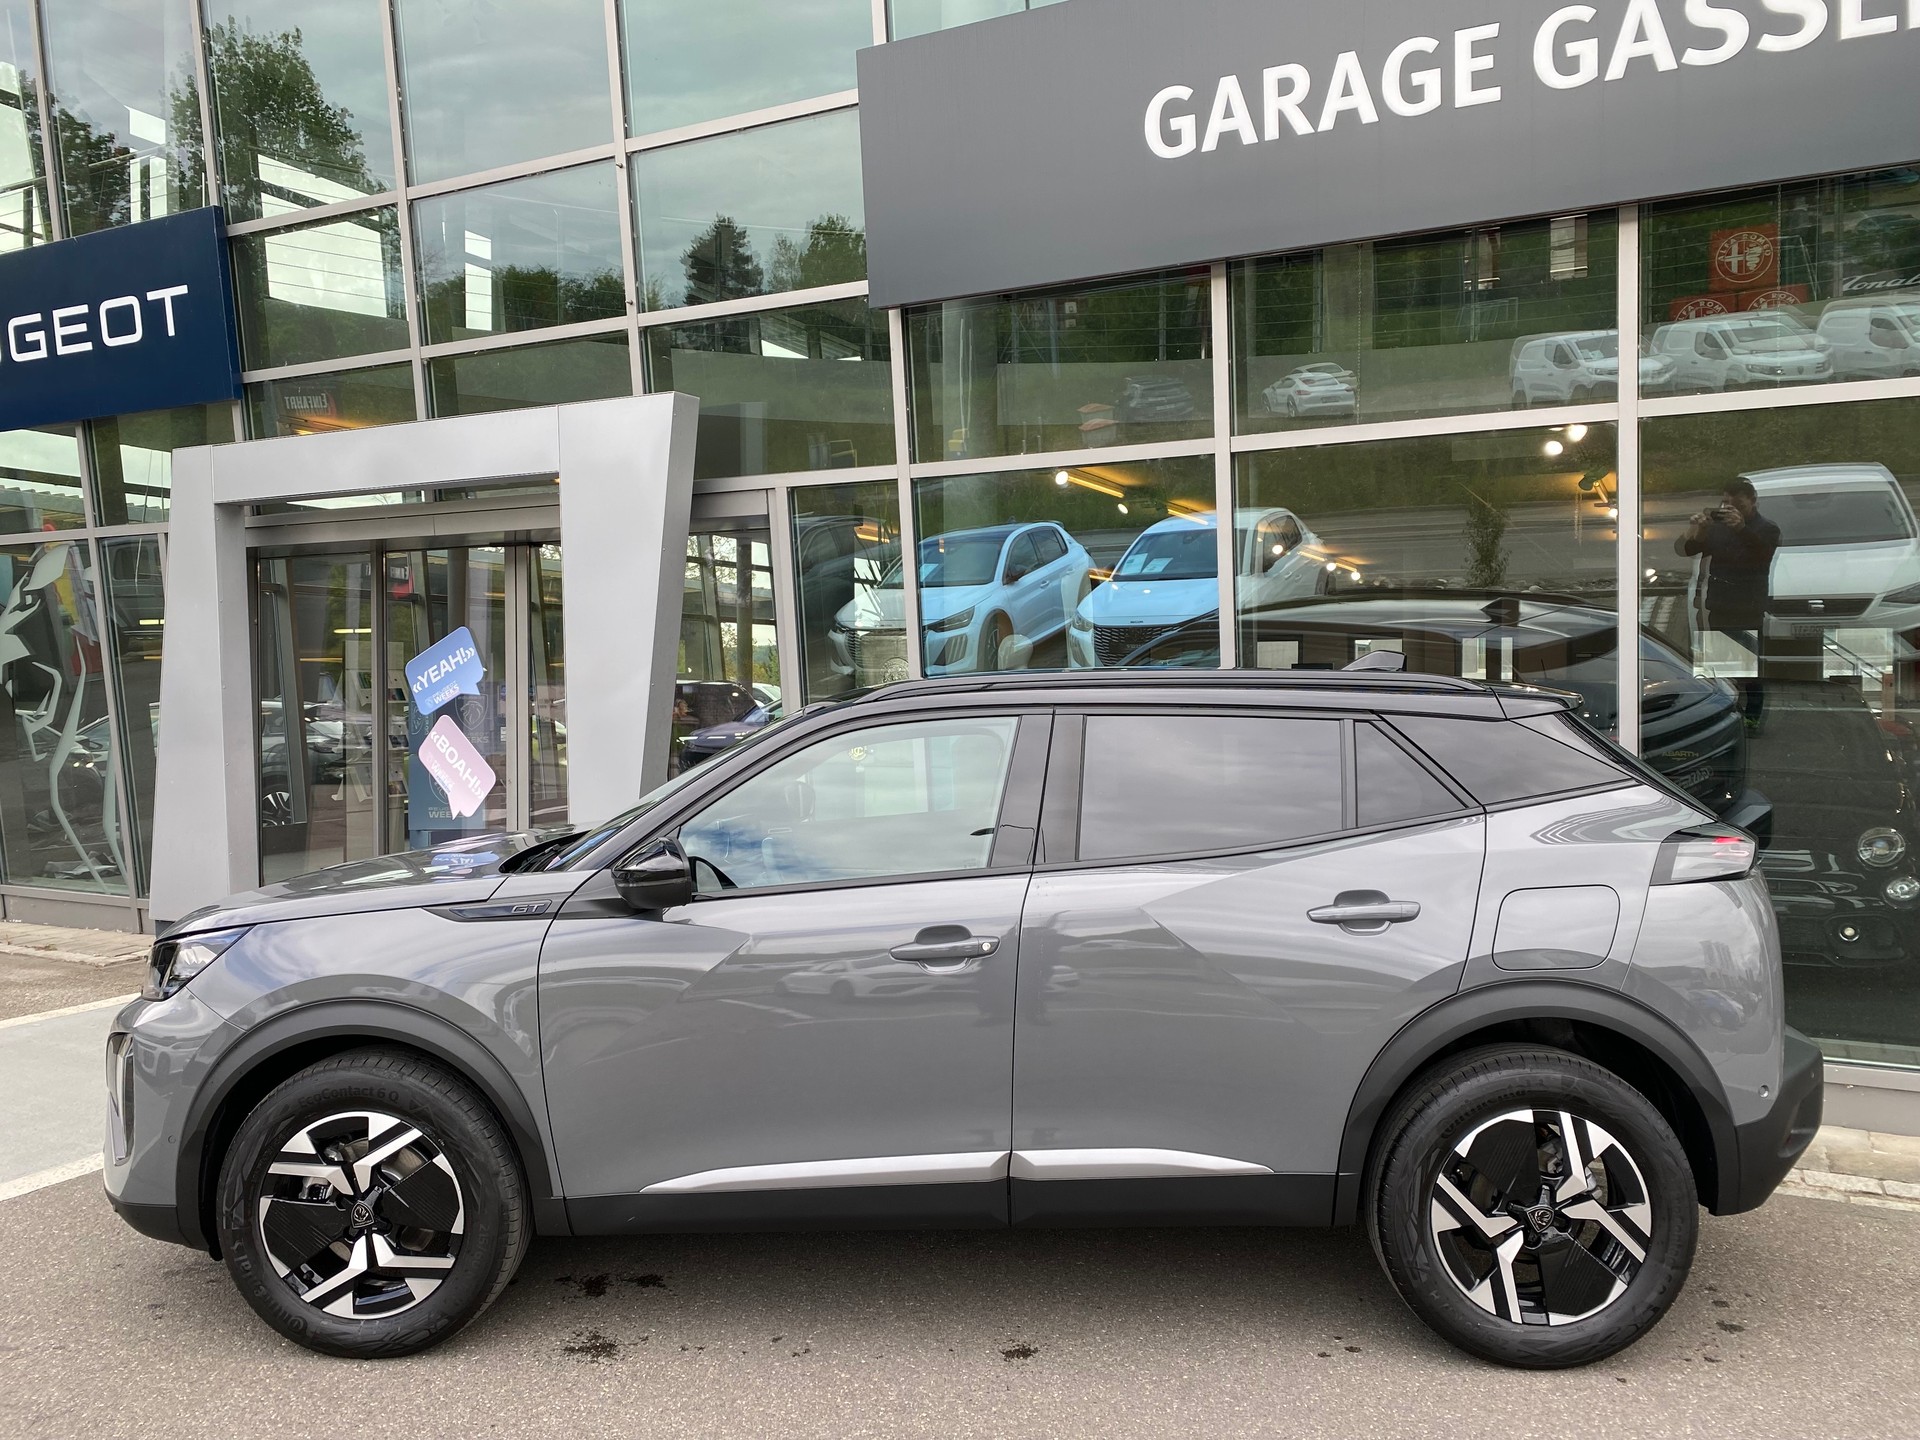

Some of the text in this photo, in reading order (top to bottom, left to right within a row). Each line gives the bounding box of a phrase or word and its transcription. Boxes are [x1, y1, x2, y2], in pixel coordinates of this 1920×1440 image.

[1144, 22, 1501, 159] GARAGE
[1742, 233, 1772, 256] ROMEO
[0, 284, 189, 362] GEOT
[512, 903, 544, 914] GT
